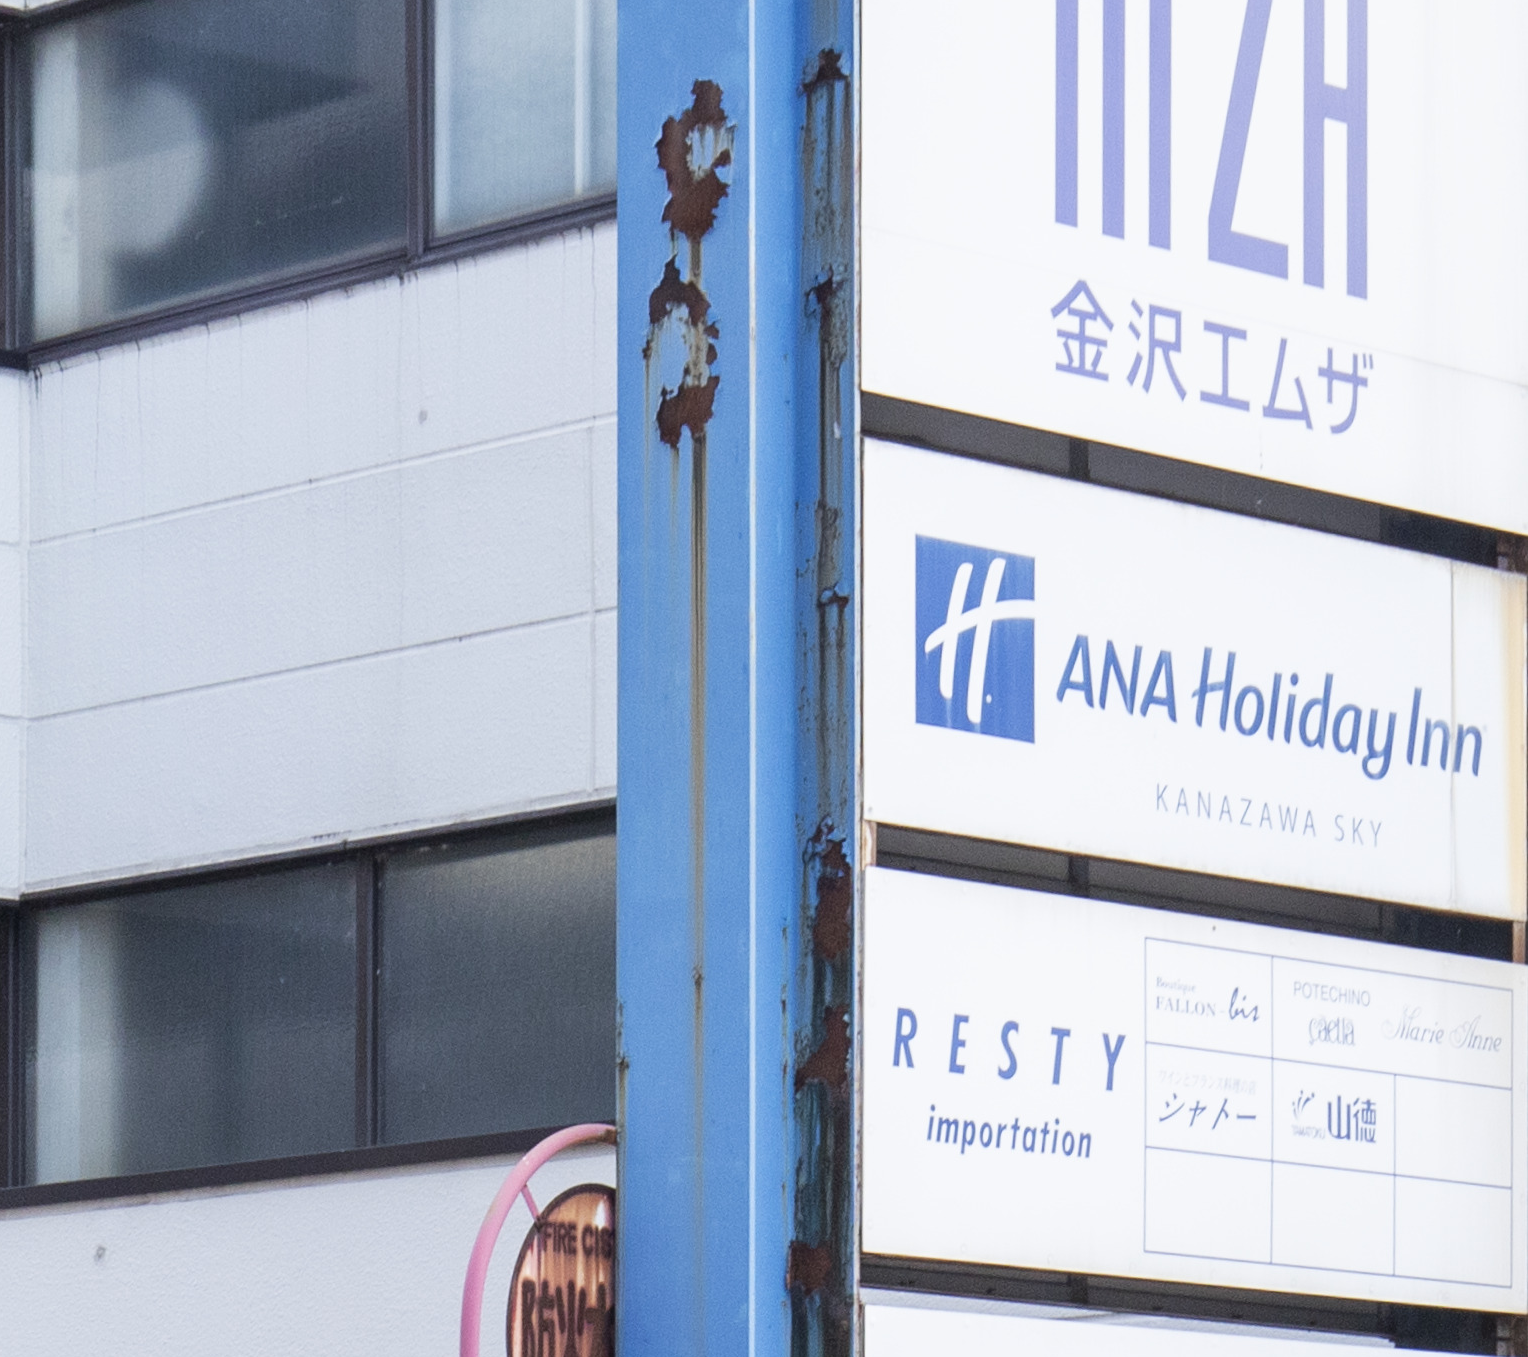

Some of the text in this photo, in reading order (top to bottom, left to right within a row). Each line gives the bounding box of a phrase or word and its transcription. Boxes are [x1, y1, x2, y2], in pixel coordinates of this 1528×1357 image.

[1051, 279, 1374, 436] 金沢エムザ
[1056, 634, 1483, 780] ANA Holiday Inn
[1156, 784, 1383, 848] KANAZAWA SKY
[1155, 976, 1196, 995] Boutique
[1155, 996, 1216, 1017] FALLON
[1293, 980, 1371, 1007] POTECHINO
[892, 1008, 1126, 1091] RESTY
[1381, 1006, 1502, 1053] Marie Anne
[927, 1105, 1092, 1158] importation
[1159, 1092, 1257, 1130] シャトー
[1327, 1095, 1377, 1144] 山徳
[541, 1219, 576, 1256] FIRE
